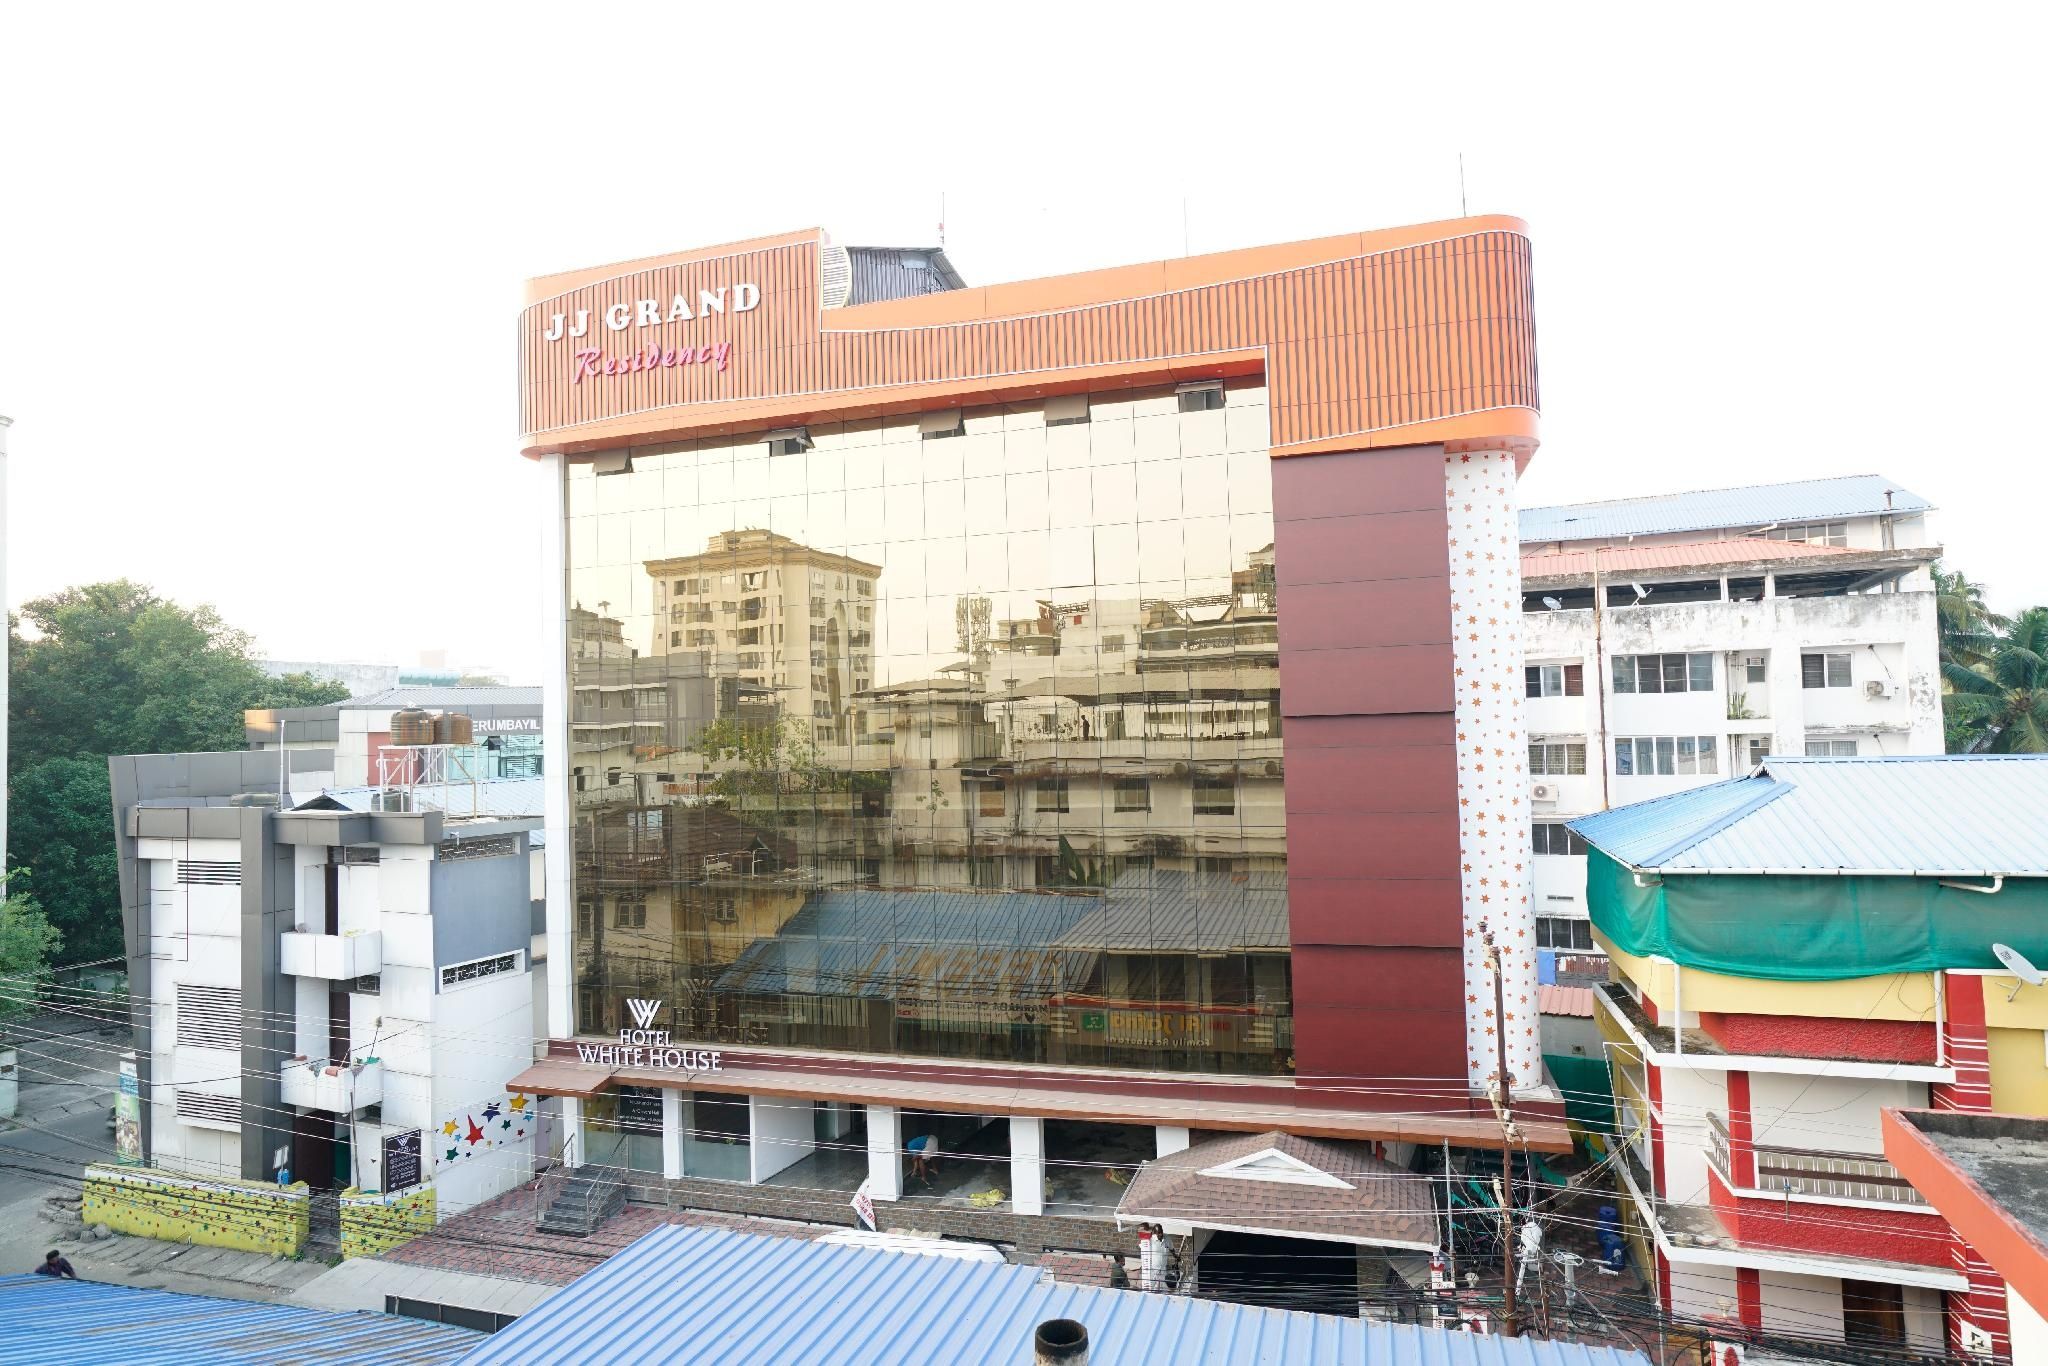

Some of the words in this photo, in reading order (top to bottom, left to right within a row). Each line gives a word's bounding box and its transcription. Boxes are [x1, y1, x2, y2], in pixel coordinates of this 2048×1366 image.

[544, 309, 591, 341] JJ
[605, 283, 761, 332] GRAND
[574, 340, 732, 385] Residency
[620, 1028, 674, 1048] HOTEL
[577, 1044, 645, 1067] WHITE
[650, 1049, 724, 1071] HOUSE
